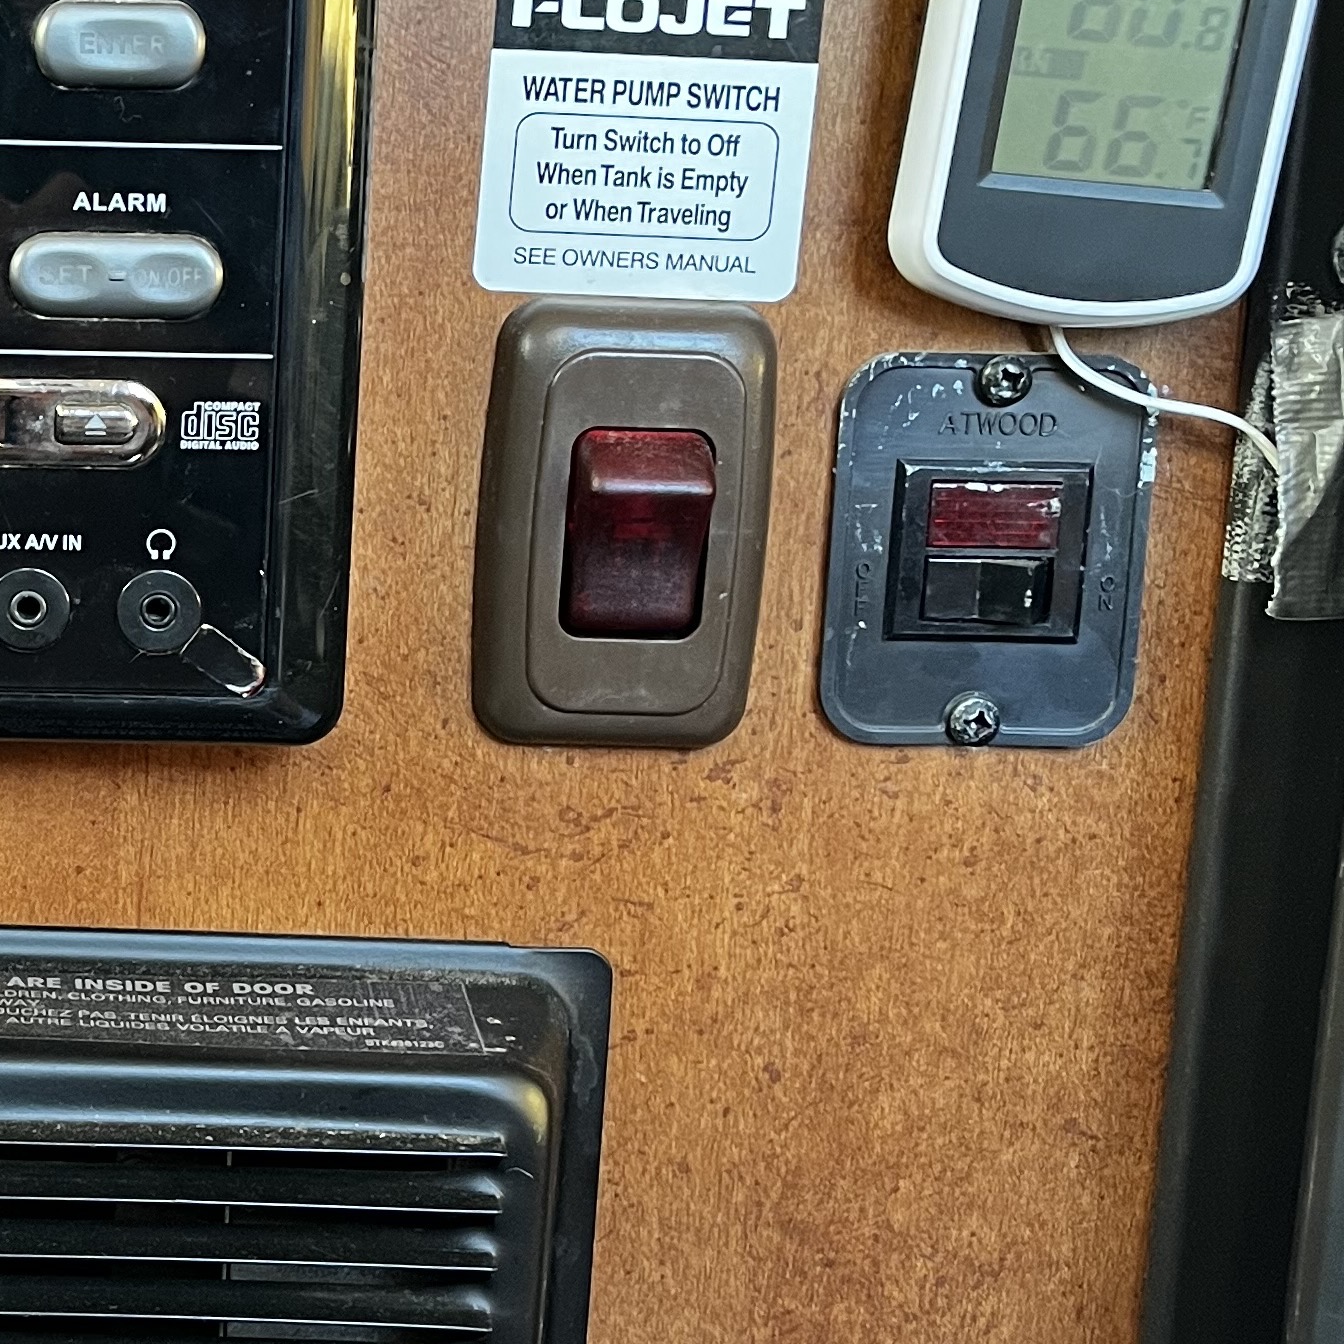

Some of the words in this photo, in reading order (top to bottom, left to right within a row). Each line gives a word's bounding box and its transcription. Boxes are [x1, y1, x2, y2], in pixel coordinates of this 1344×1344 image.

[523, 74, 606, 105] WATER
[612, 79, 681, 108] PUMP
[686, 83, 781, 113] SWITCH
[550, 126, 597, 151] Turn
[603, 128, 675, 155] Switch
[680, 135, 702, 156] to
[707, 134, 742, 158] Off
[537, 161, 596, 186] When
[600, 165, 651, 189] Tank
[657, 167, 675, 190] is
[680, 168, 750, 199] Empty
[72, 192, 168, 214] ALARM
[545, 203, 568, 221] or
[572, 199, 632, 224] When
[637, 201, 732, 233] Traveling
[513, 246, 556, 267] SEE
[562, 249, 660, 270] OWNERS
[665, 253, 757, 274] MANUAL
[205, 400, 261, 412] COMPACT
[938, 411, 1058, 438] ATWOOD
[179, 439, 223, 450] DIGITAL
[224, 440, 260, 451] AUDIO
[24, 533, 59, 552] A/V
[62, 535, 83, 552] IN
[6, 976, 62, 989] ARE
[74, 978, 172, 993] INSIDE
[183, 981, 221, 994] OF
[232, 982, 315, 996] DOOR
[296, 997, 395, 1008] GASOLINE
